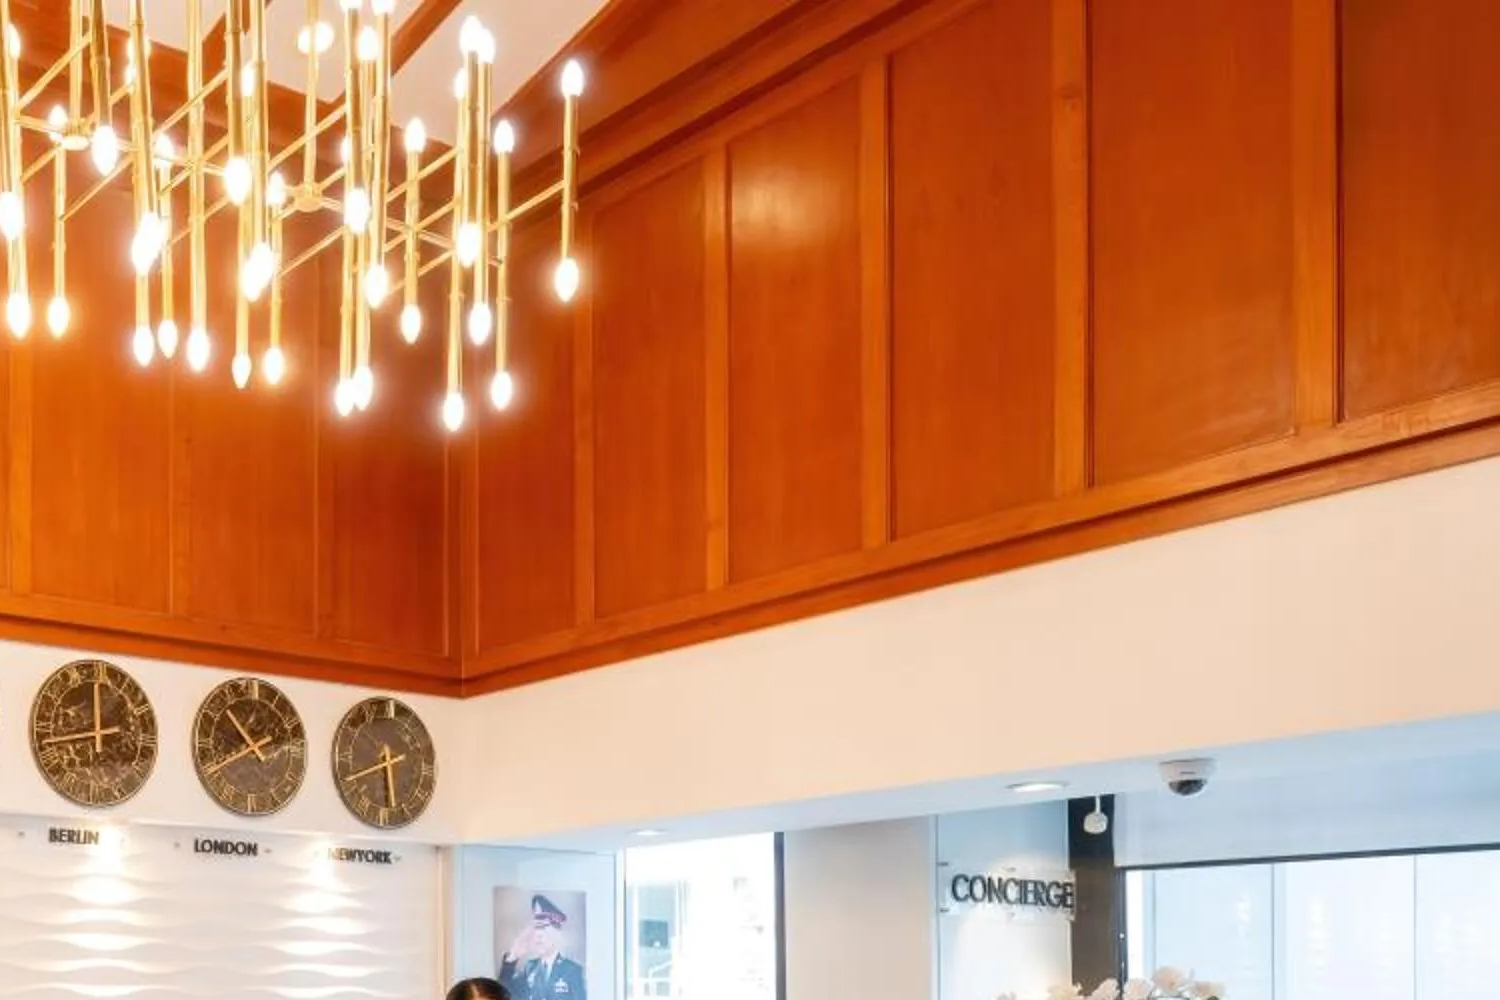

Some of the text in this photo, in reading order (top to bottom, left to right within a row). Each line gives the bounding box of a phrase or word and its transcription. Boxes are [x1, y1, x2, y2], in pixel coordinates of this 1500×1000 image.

[49, 828, 100, 845] BERLIN
[194, 838, 258, 856] LONDON
[951, 873, 1074, 909] CONCIERGE
